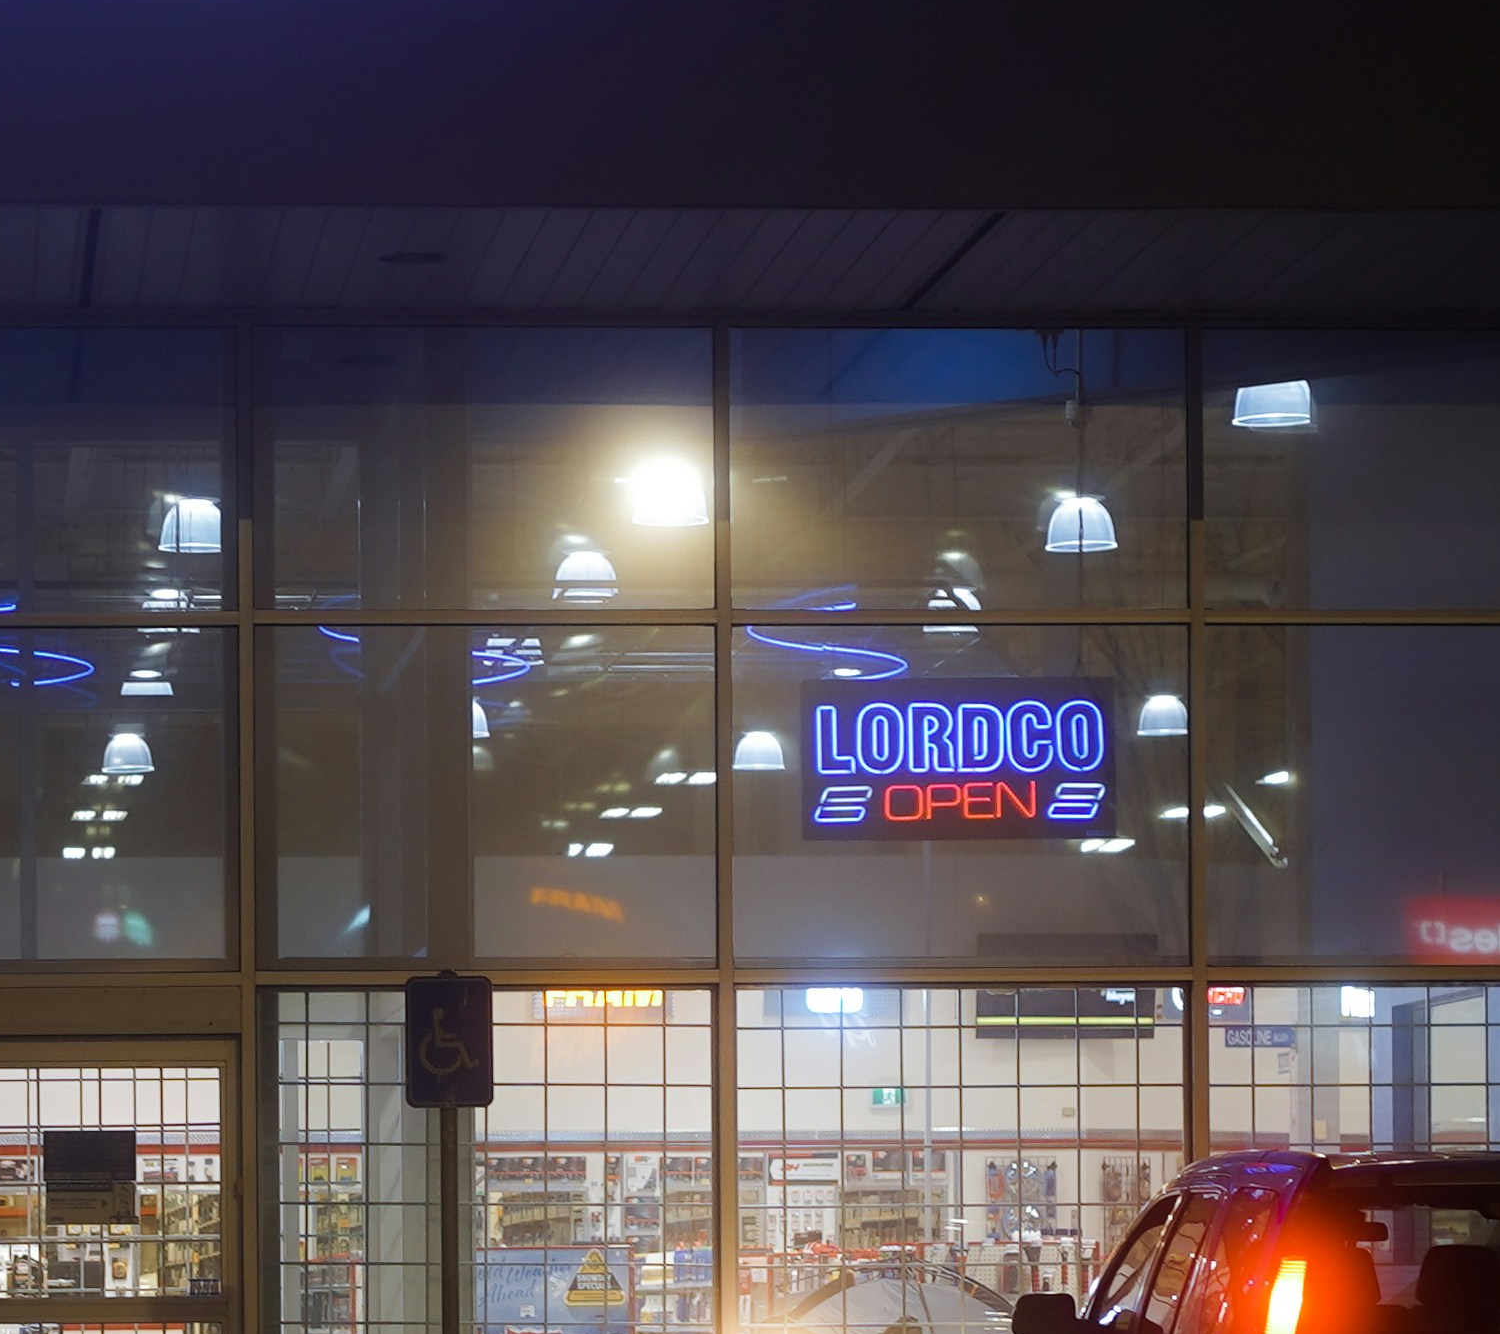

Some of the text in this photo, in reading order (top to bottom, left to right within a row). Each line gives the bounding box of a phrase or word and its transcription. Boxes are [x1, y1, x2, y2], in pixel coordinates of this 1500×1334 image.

[815, 700, 1105, 775] LORDCO
[883, 781, 1037, 821] OPEN
[1227, 1029, 1273, 1046] GASOINE
